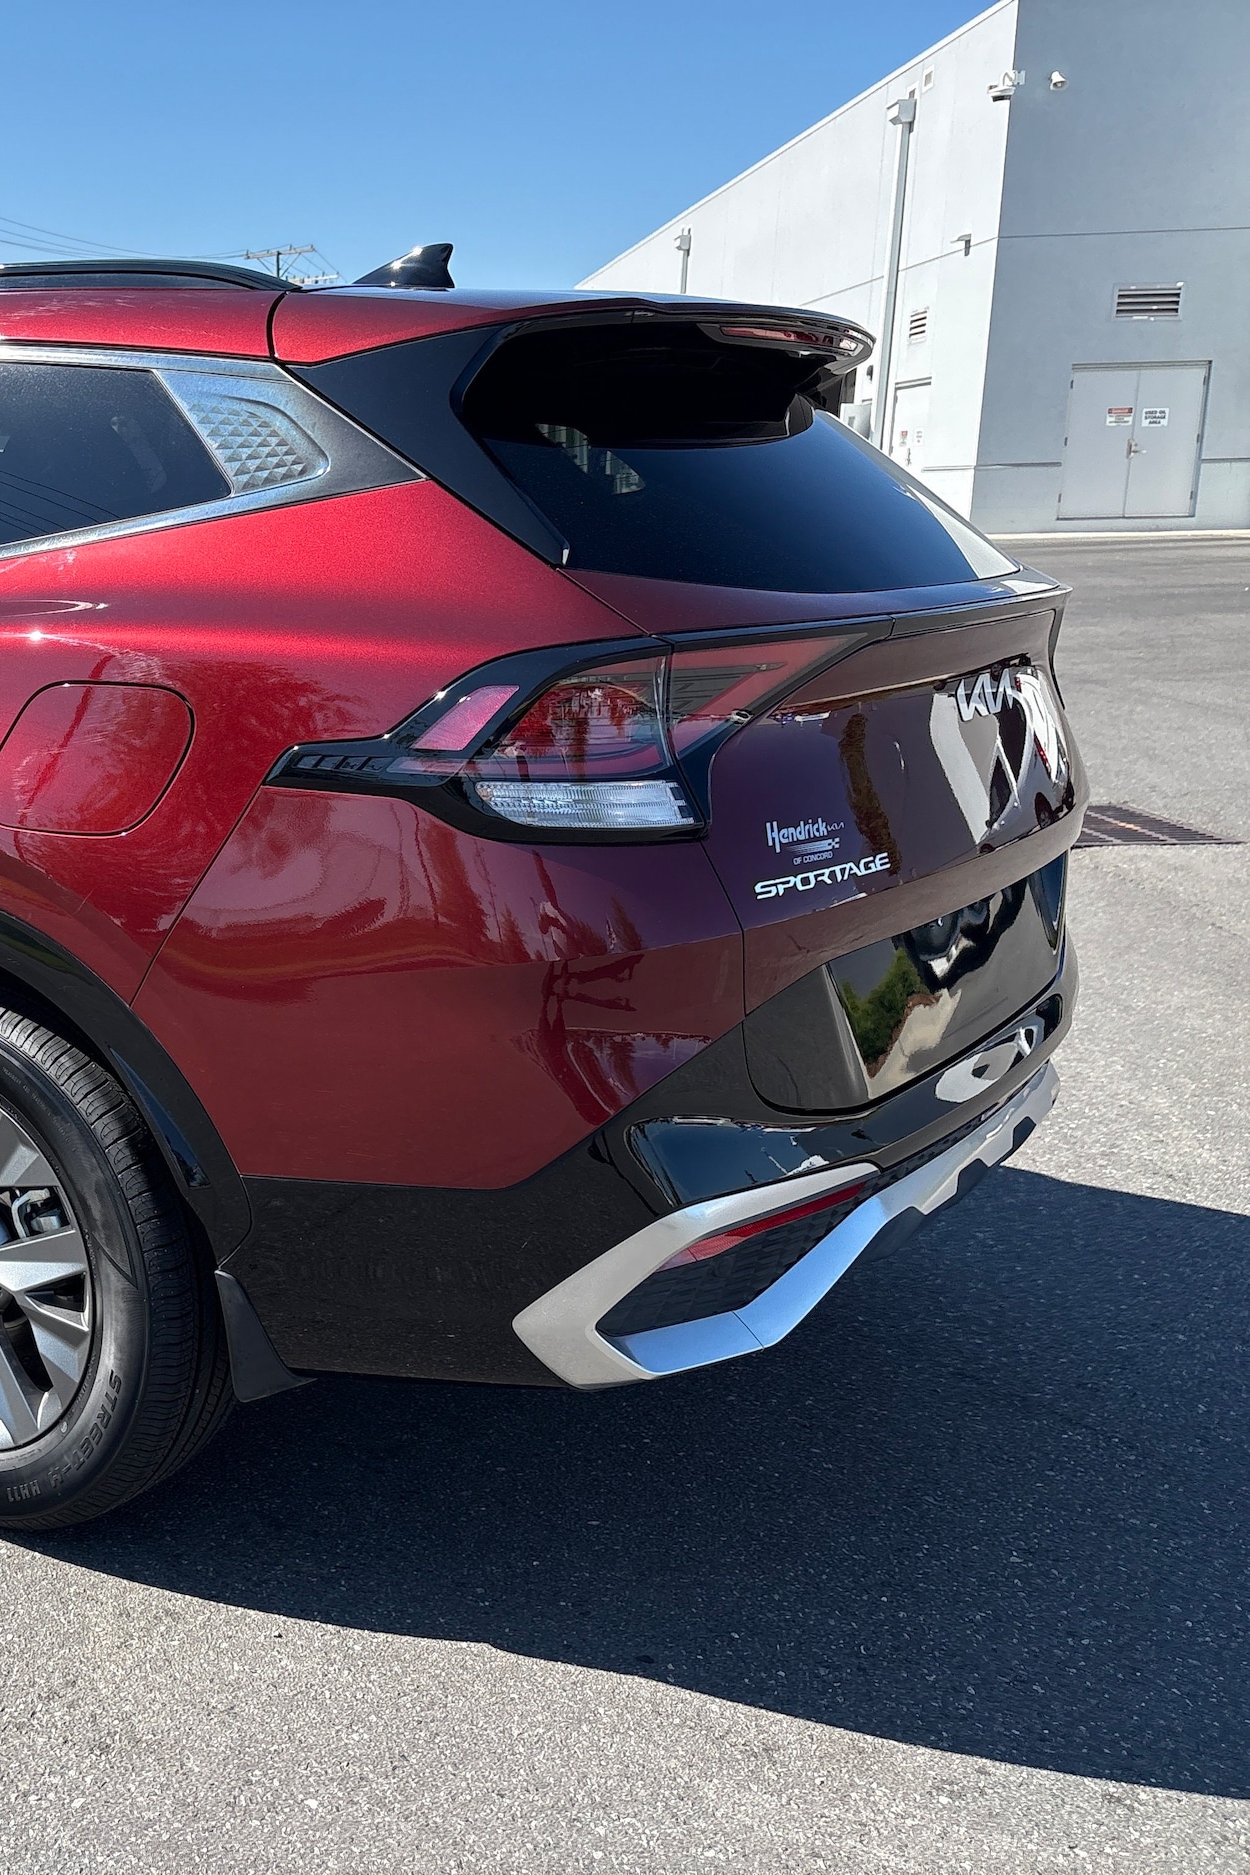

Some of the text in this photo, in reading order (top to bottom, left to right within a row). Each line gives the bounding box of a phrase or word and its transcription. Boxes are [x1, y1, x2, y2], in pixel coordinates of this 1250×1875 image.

[766, 817, 828, 853] Hendrick
[754, 852, 891, 900] SPORTAGE
[793, 851, 833, 865] OF CONCORD
